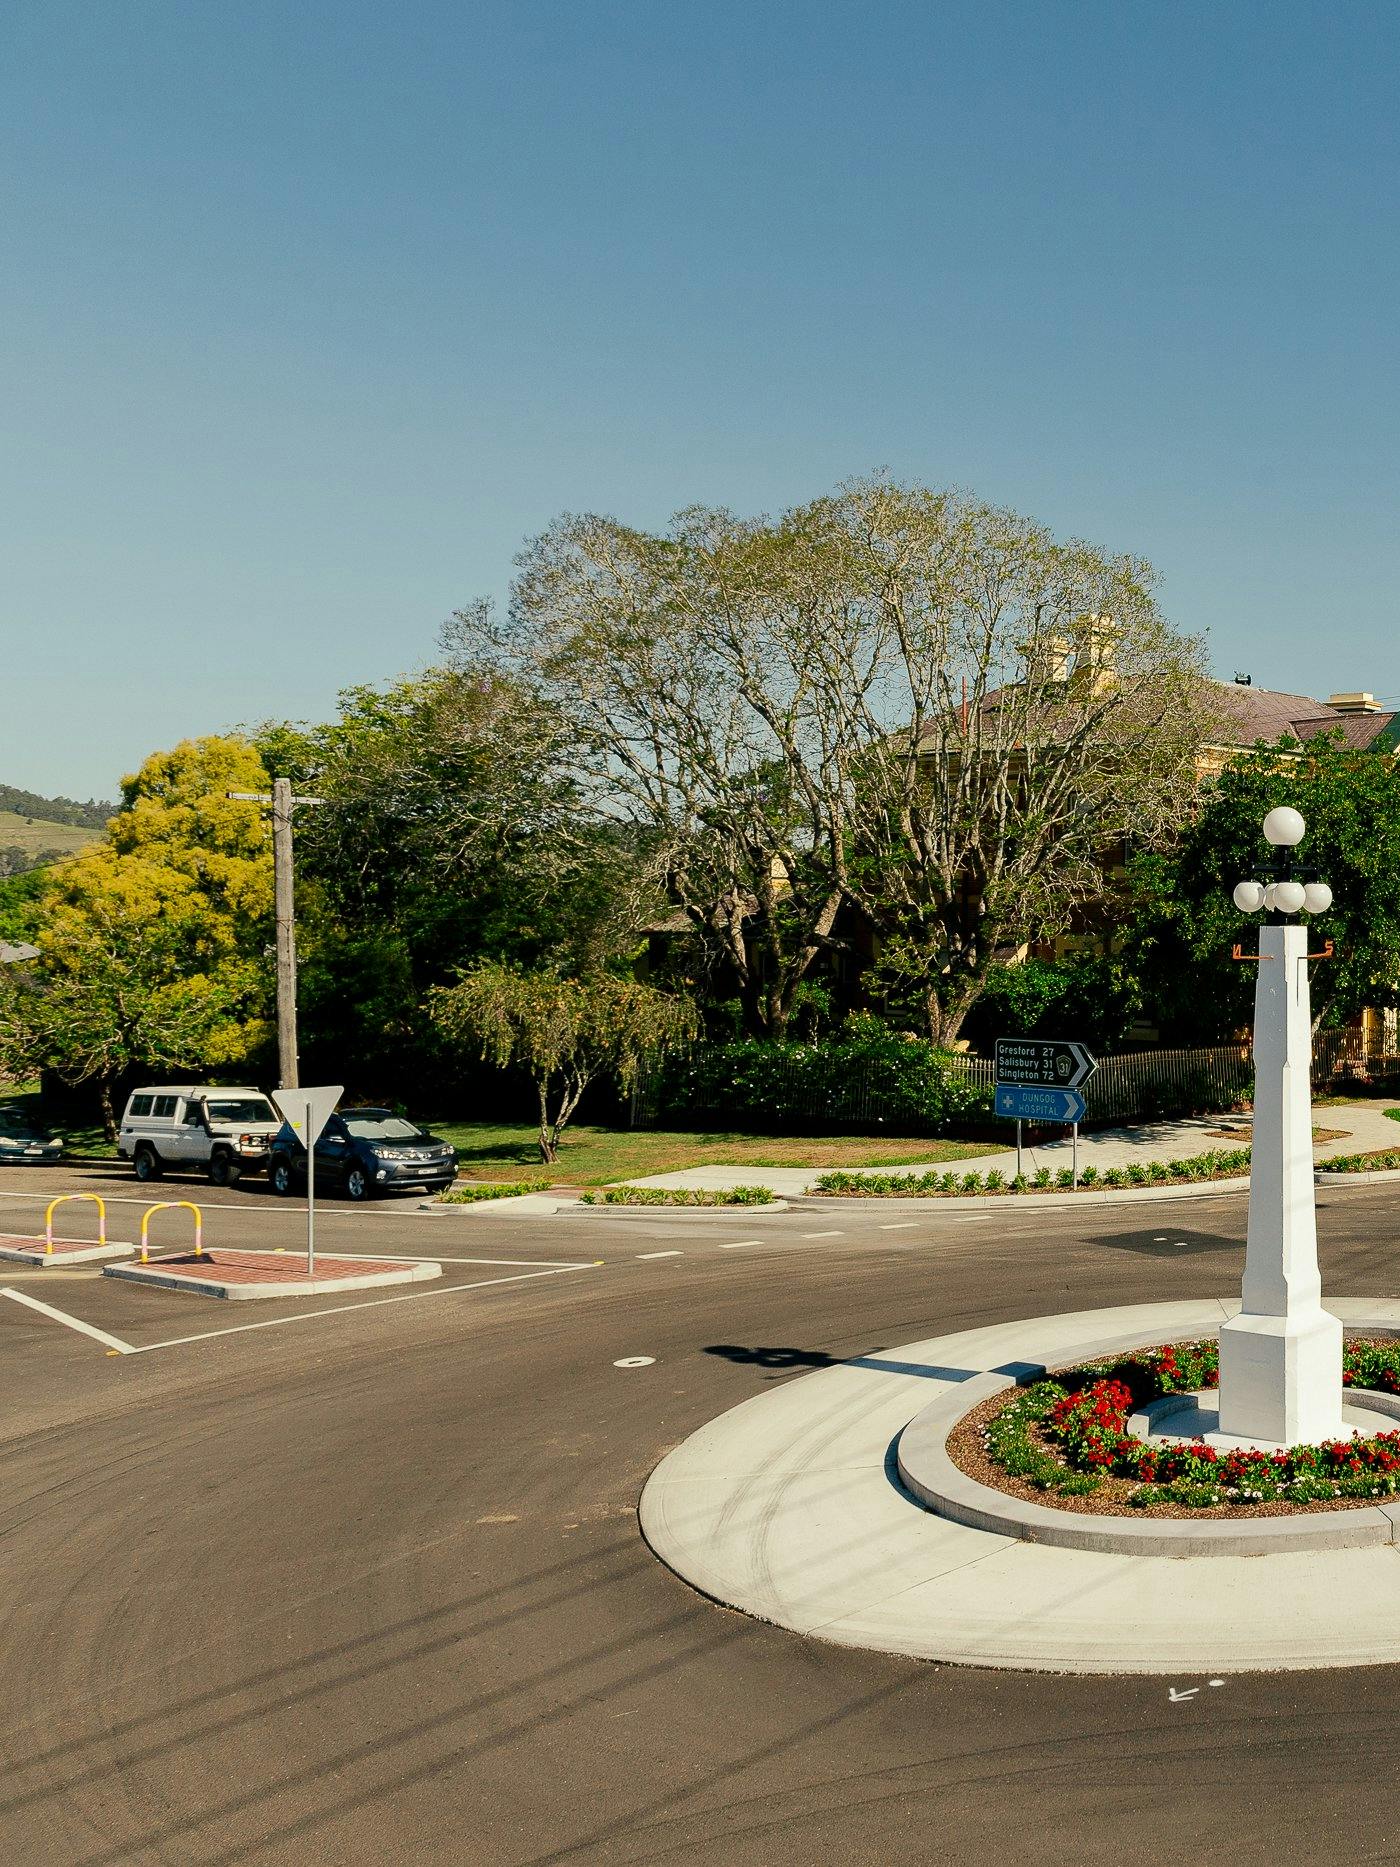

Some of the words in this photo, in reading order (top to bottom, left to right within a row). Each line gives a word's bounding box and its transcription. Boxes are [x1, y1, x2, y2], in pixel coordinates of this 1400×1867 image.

[999, 1045, 1035, 1056] Gresford
[1042, 1047, 1054, 1057] 27
[999, 1056, 1039, 1069] Salisbury
[1043, 1059, 1053, 1069] 31
[1059, 1062, 1069, 1073] 31
[999, 1068, 1039, 1080] Singleton
[1042, 1071, 1054, 1080] 72
[1022, 1093, 1056, 1103] DUNGOG
[1018, 1104, 1058, 1115] HOSPITAL
